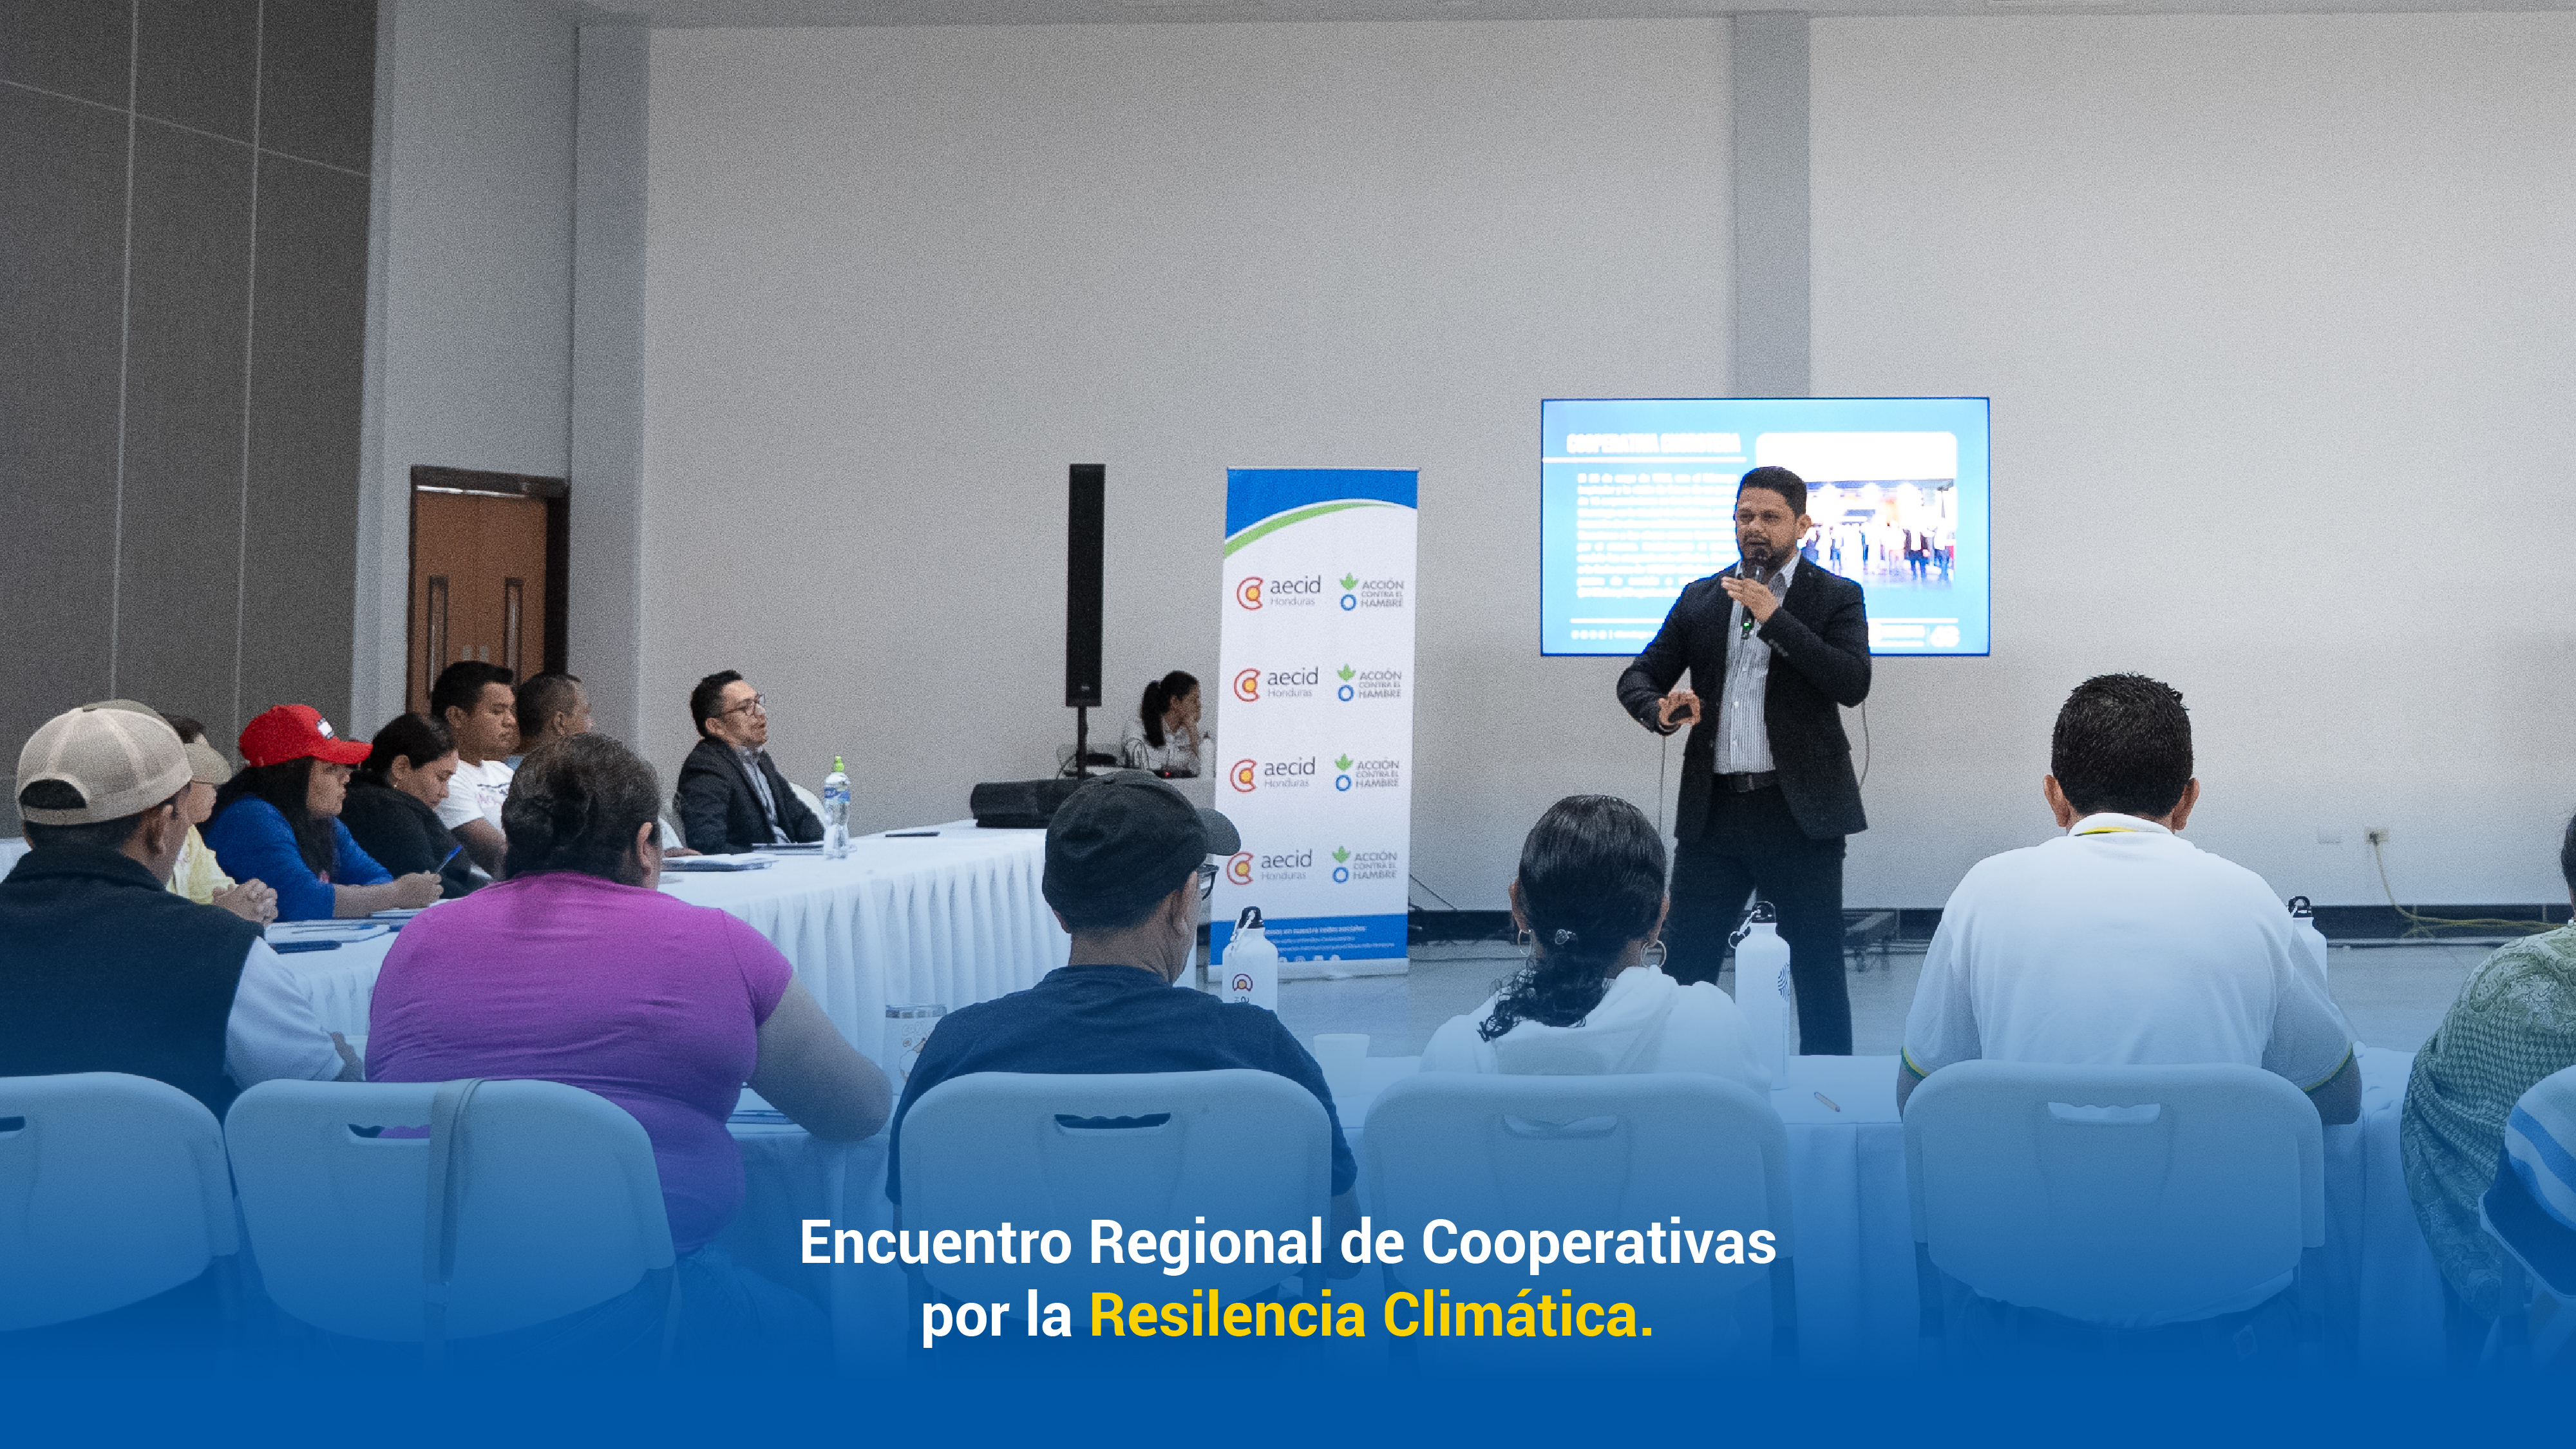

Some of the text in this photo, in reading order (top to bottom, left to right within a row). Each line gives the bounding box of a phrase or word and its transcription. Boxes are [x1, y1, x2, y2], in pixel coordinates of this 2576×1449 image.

[1270, 574, 1321, 594] aecid
[1362, 577, 1405, 590] ACCIÓN
[1270, 597, 1316, 606] Honduras
[1361, 599, 1403, 608] HAMBRE
[1267, 666, 1318, 686] aecid
[1359, 667, 1402, 680] ACCIÓN
[1267, 688, 1313, 697] Honduras
[1358, 689, 1401, 699] HAMBRE
[1264, 756, 1316, 776] aecid
[1357, 757, 1399, 770] ACCIÓN
[1264, 778, 1309, 788] Honduras
[1356, 778, 1399, 788] HAMBRE
[1262, 848, 1312, 869] aecid
[1354, 849, 1397, 862] ACCIÓN
[1262, 871, 1307, 880] Honduras
[1353, 869, 1397, 880] HAMBRE
